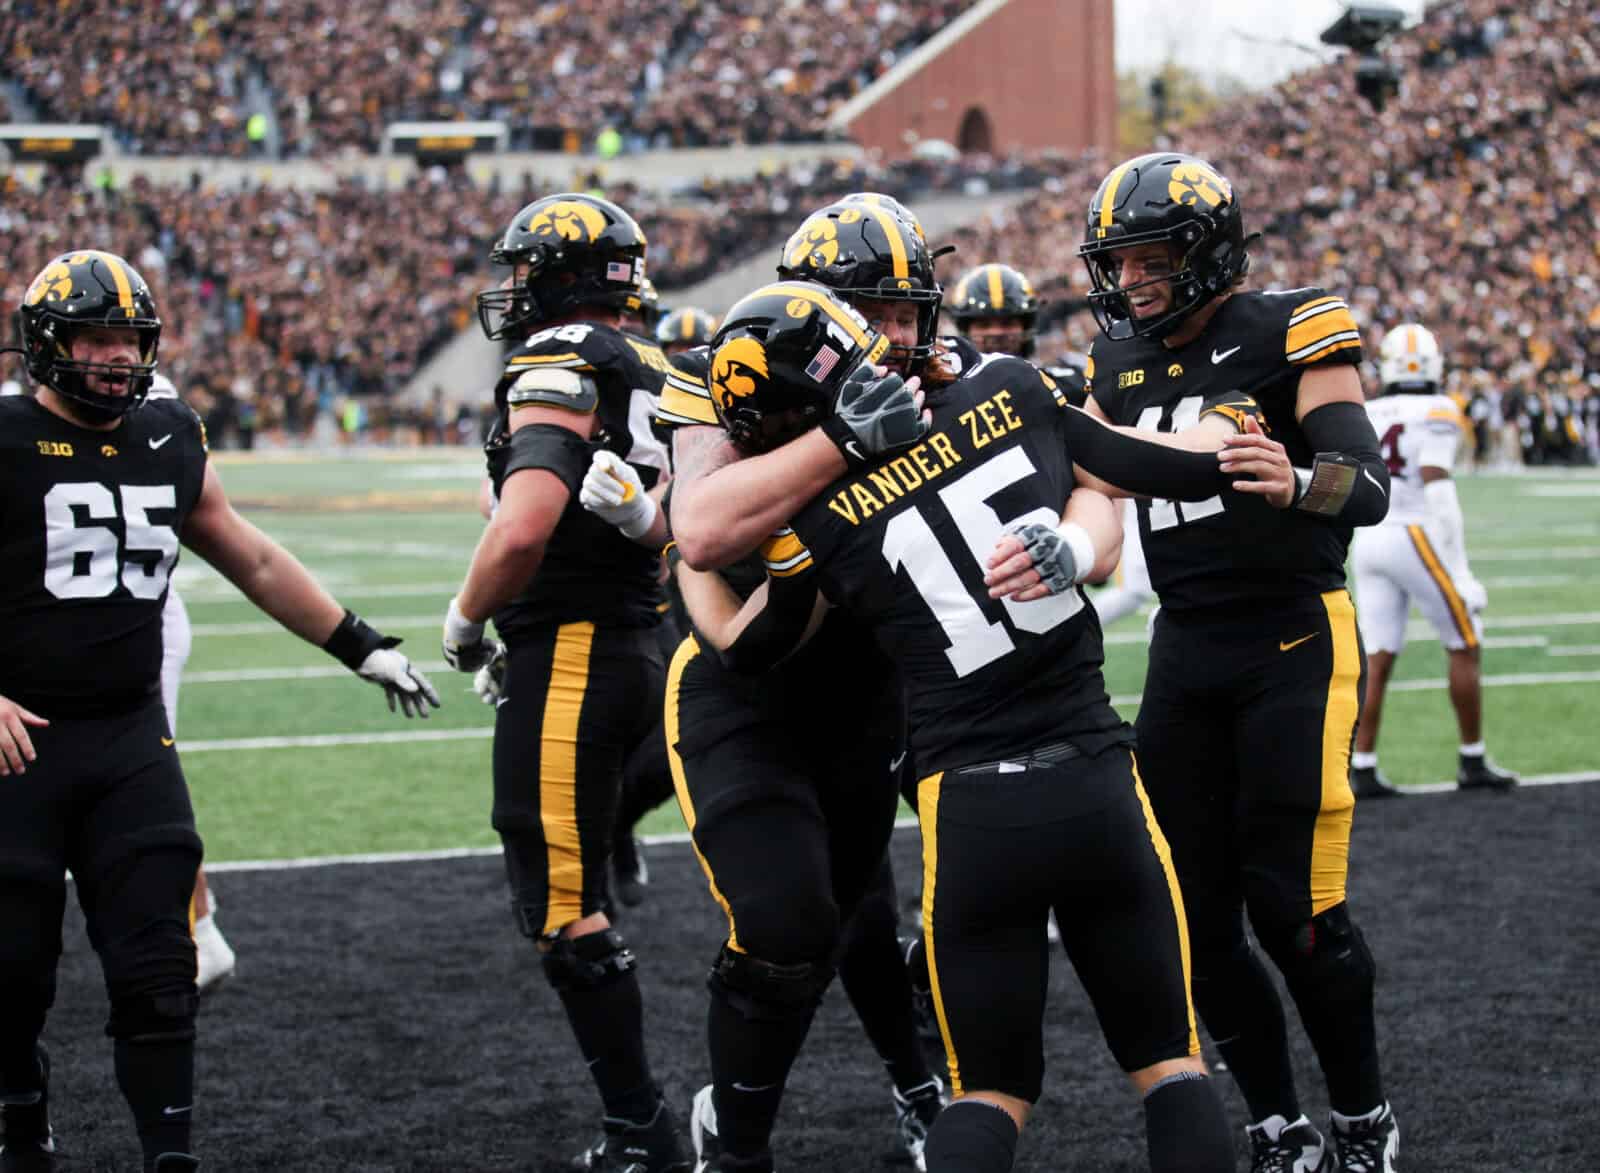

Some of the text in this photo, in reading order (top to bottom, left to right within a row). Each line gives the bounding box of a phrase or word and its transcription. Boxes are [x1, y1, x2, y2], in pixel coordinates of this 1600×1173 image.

[828, 389, 1024, 527] VANDER ZEE
[44, 482, 179, 600] 65
[881, 444, 1085, 679] 15
